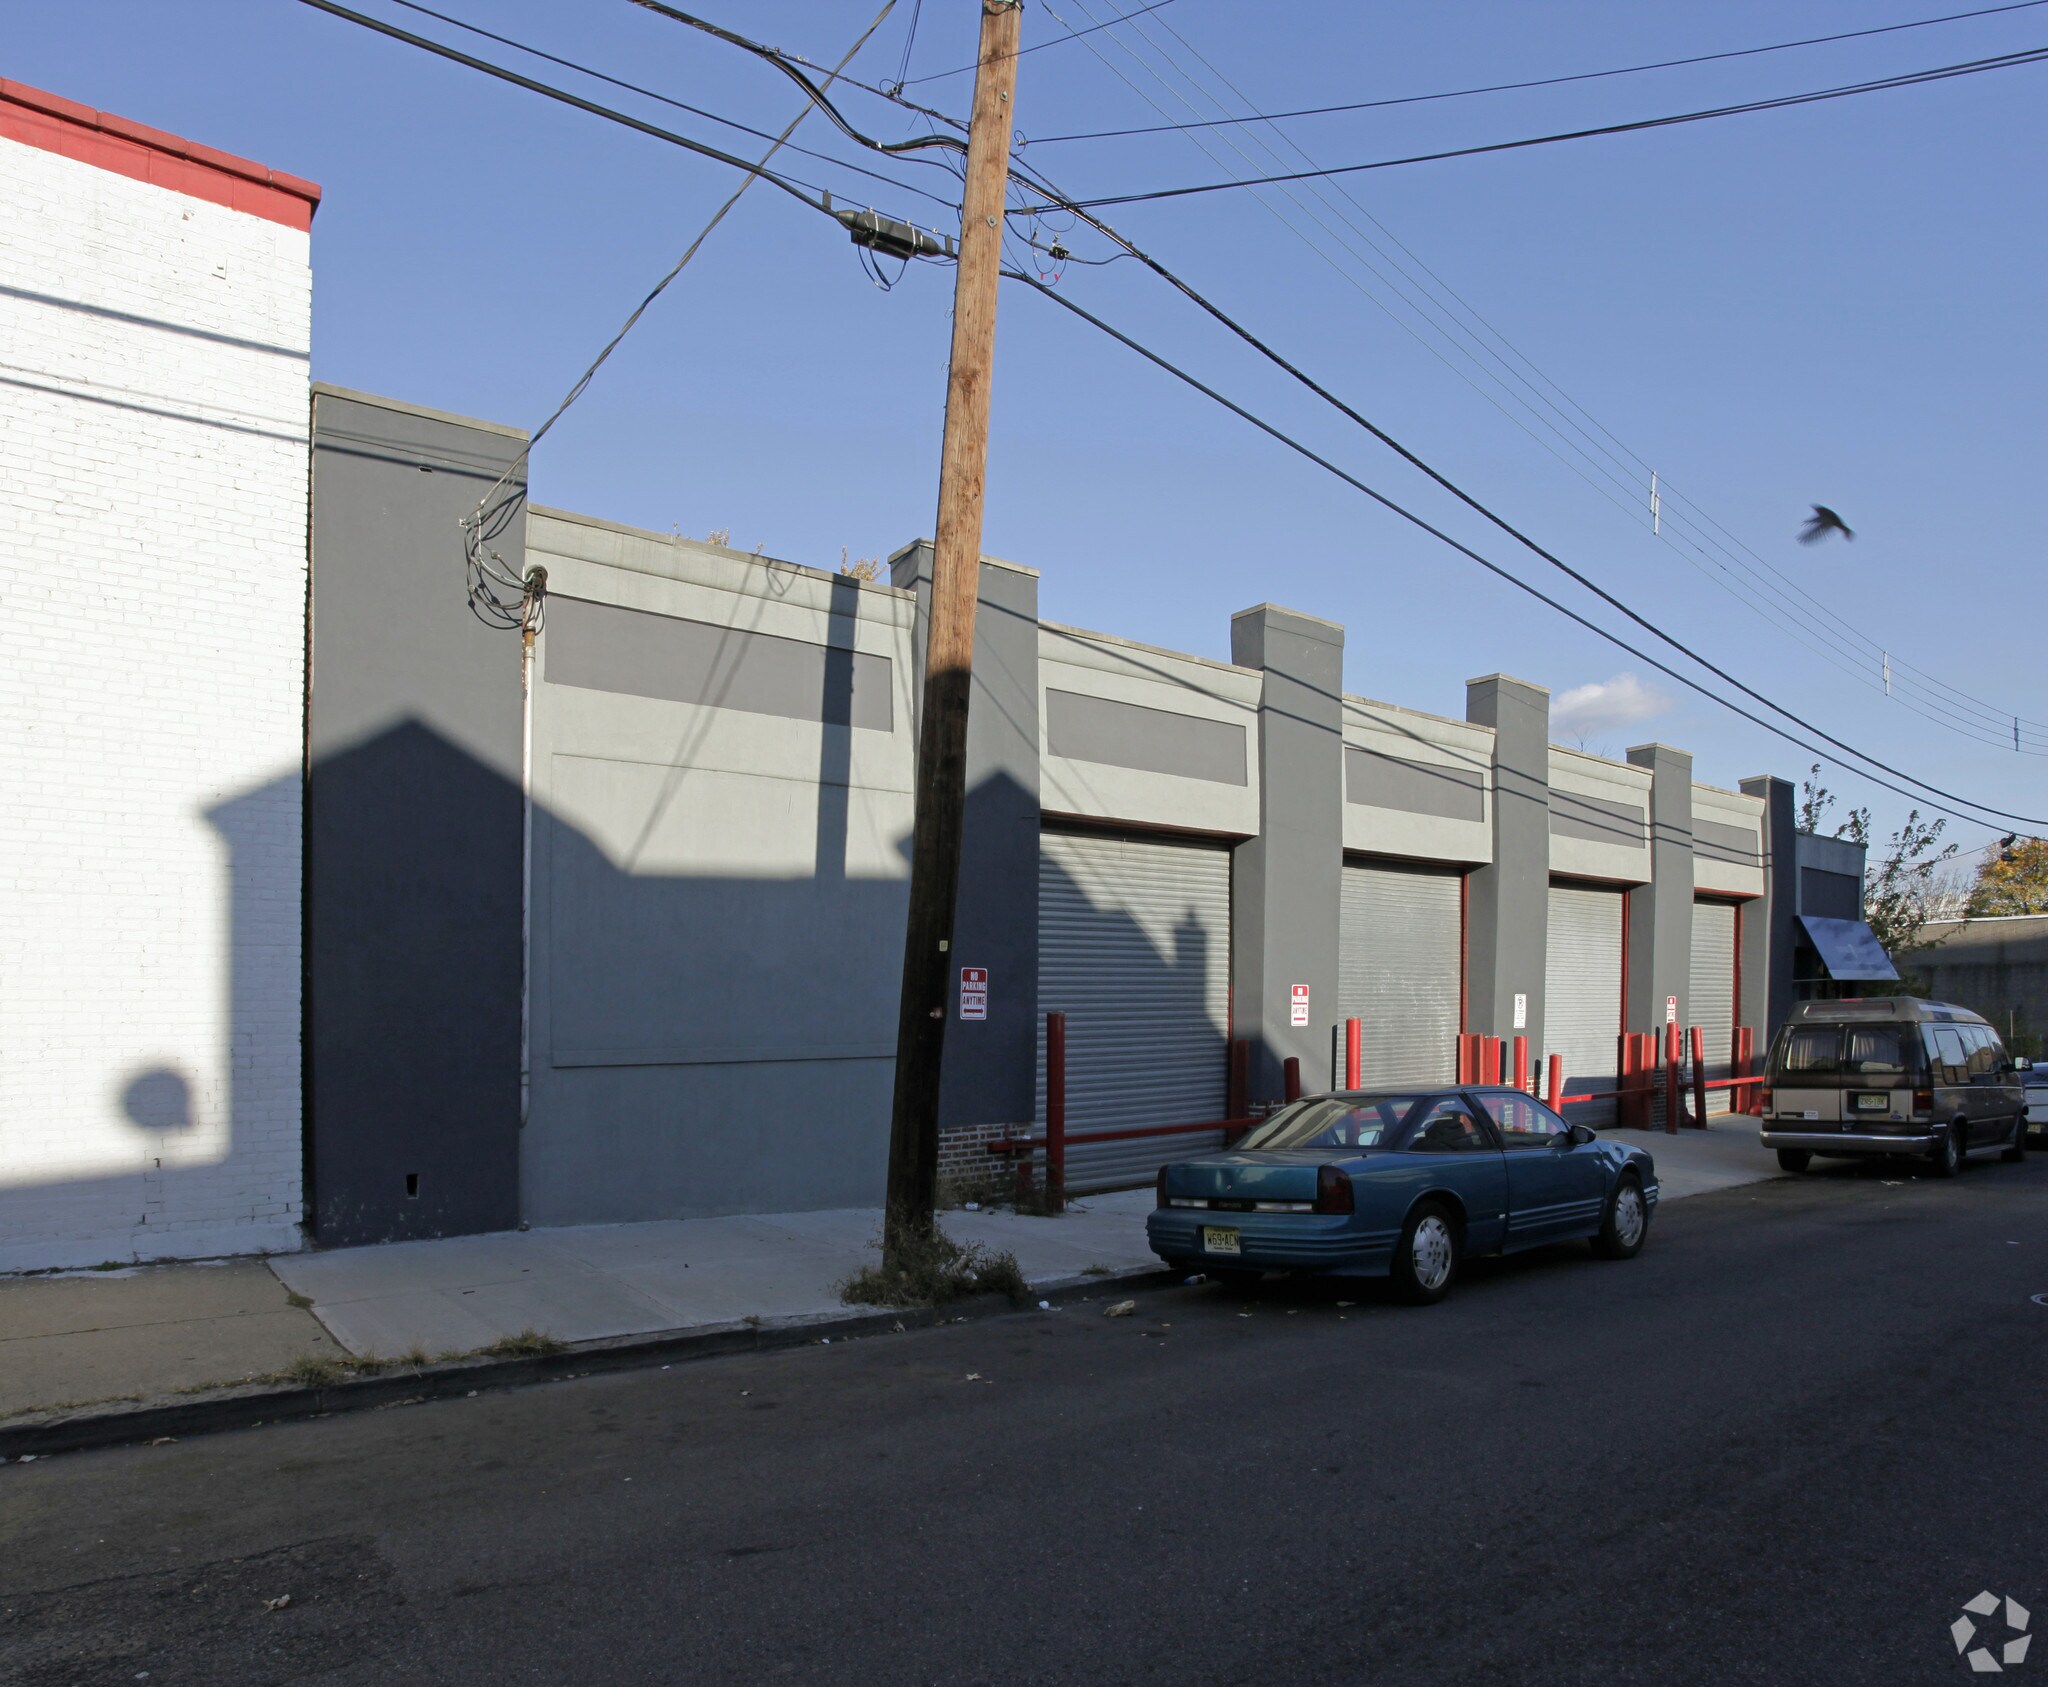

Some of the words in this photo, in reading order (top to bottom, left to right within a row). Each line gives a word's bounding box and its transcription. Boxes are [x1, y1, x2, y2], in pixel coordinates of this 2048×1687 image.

[970, 971, 979, 981] NO
[962, 981, 986, 991] PARKING
[963, 996, 985, 1005] ANYTIME
